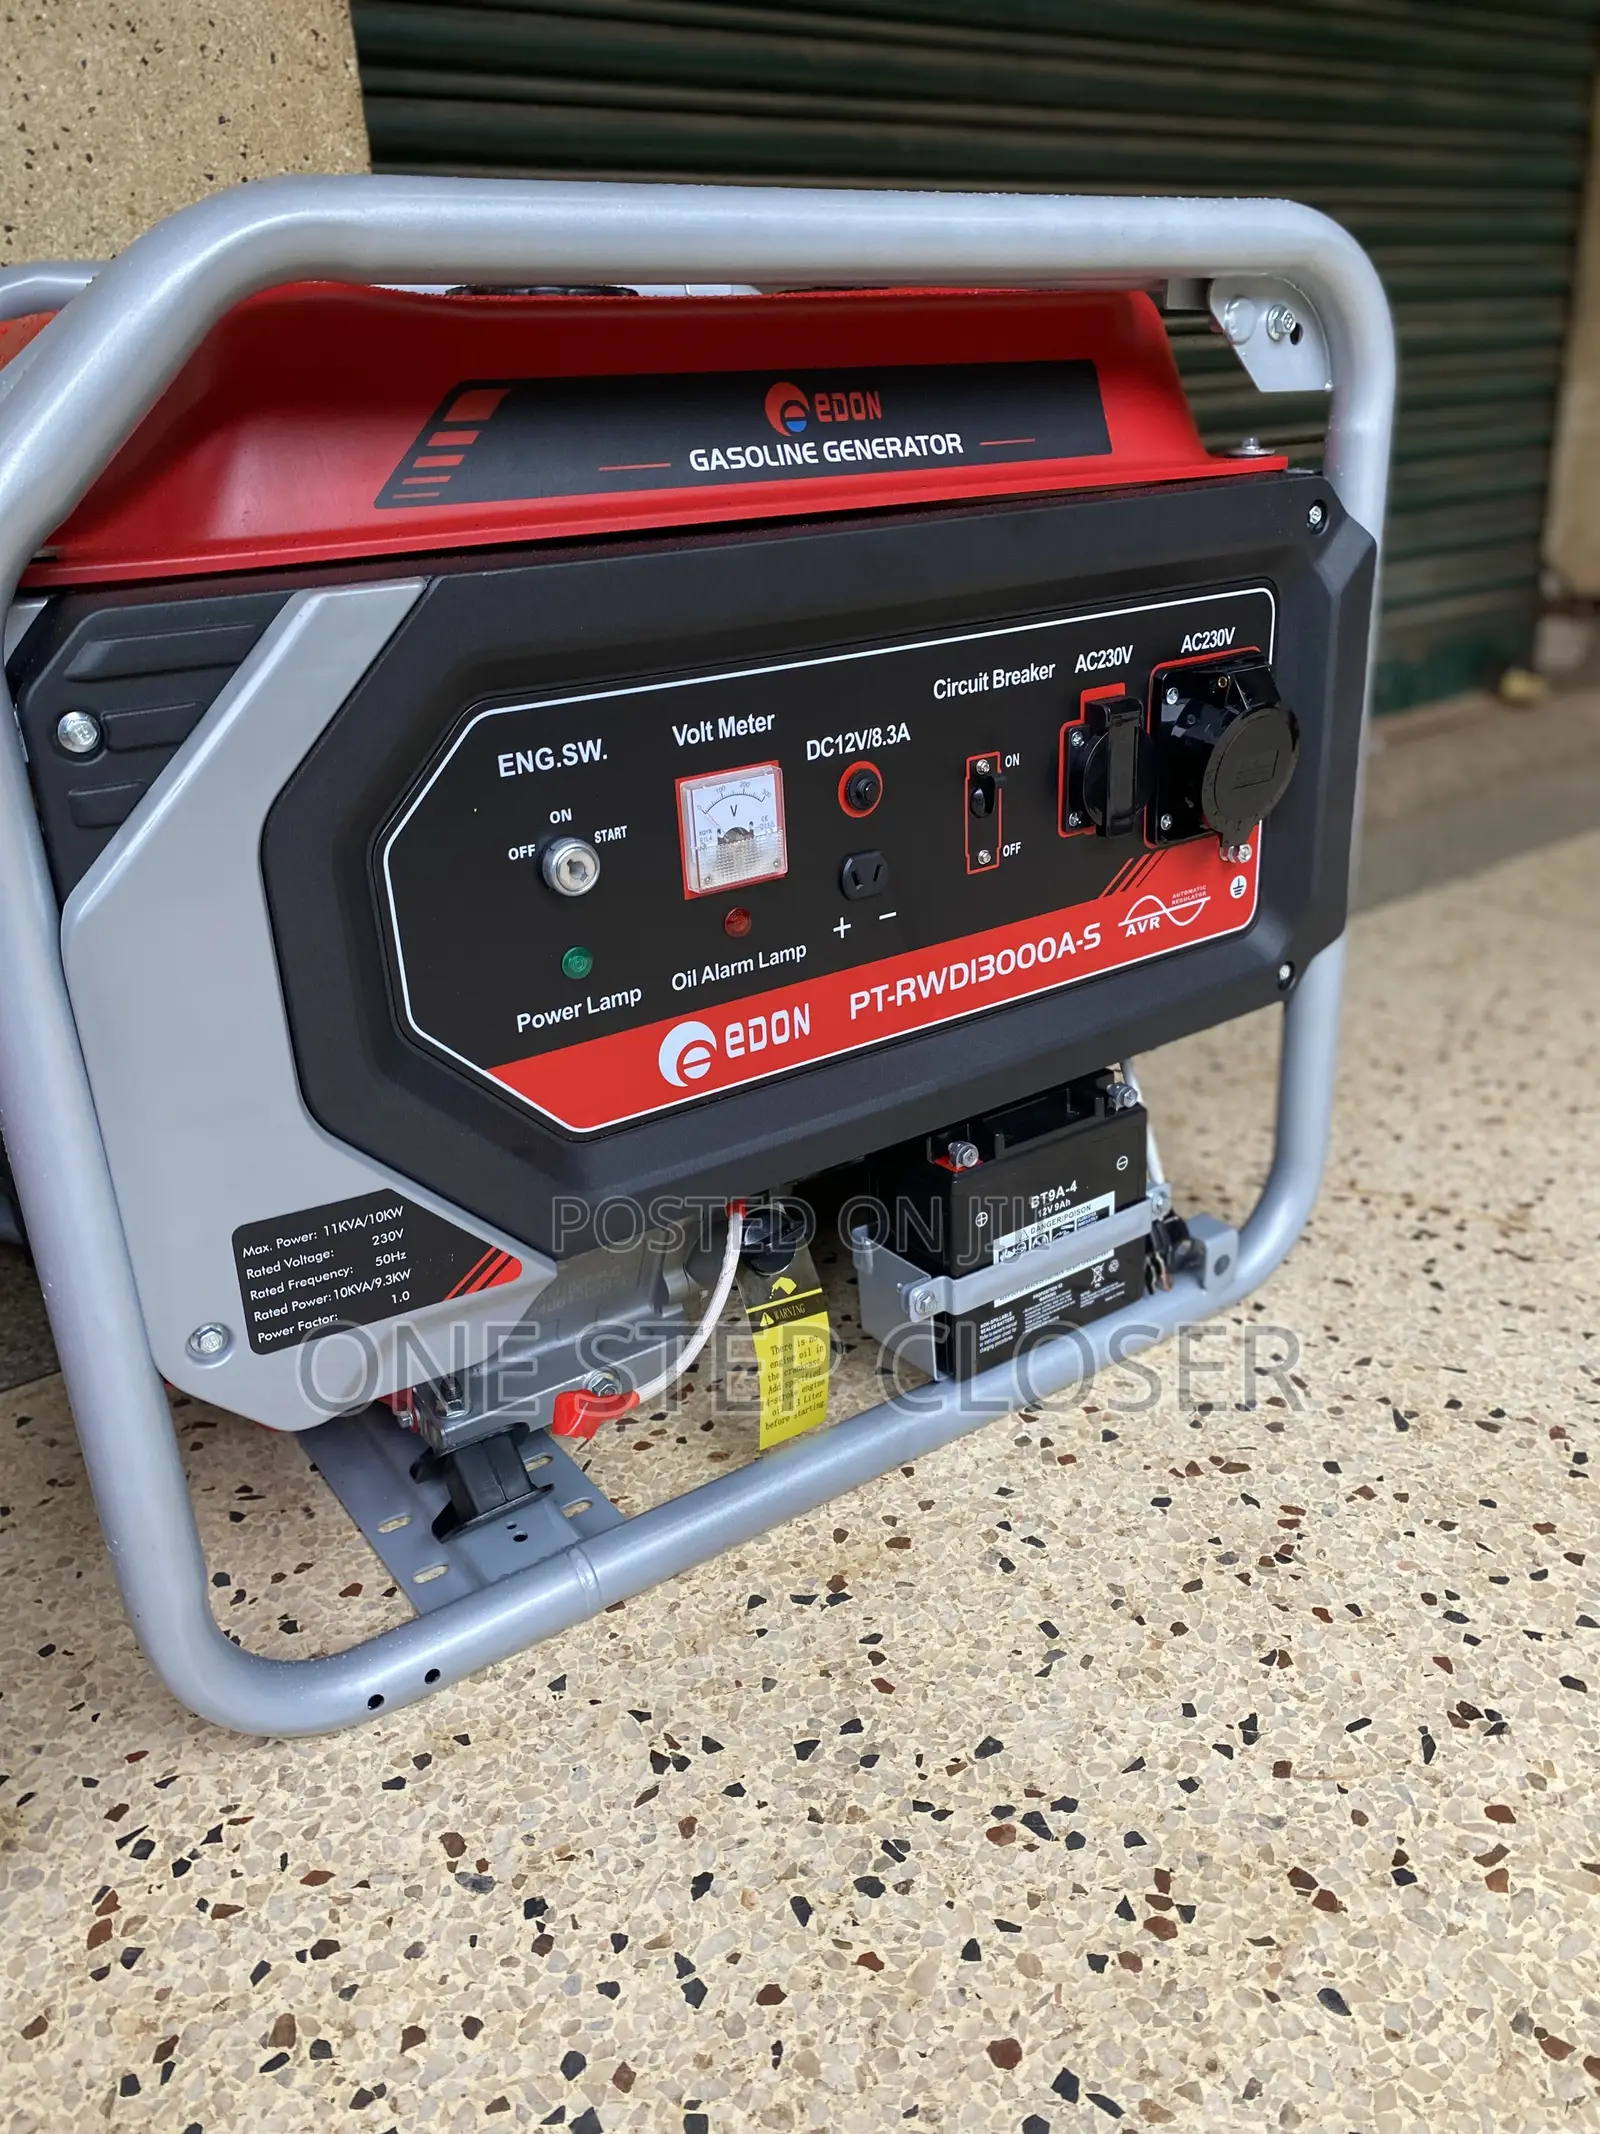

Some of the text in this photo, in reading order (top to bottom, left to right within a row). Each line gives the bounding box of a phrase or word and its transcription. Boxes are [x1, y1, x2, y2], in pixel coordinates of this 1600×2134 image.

[689, 433, 963, 473] GASOLINE GENERATOR
[1181, 626, 1236, 653] AC230V
[1075, 645, 1133, 673] AC230V
[933, 662, 1056, 700] Circuit Breaker
[671, 712, 775, 747] Volt Meter
[806, 722, 911, 760] DC12V/8.3A
[497, 738, 608, 778] ENG.SW.
[1004, 752, 1020, 768] ON
[549, 808, 573, 824] ON
[730, 804, 738, 817] V
[594, 825, 628, 844] START
[508, 844, 536, 861] OFF
[1002, 841, 1022, 858] OFF
[1172, 884, 1207, 899] AUTOMATIC
[1125, 916, 1161, 938] AVR
[671, 943, 807, 991] Oil Alarm Lamp
[517, 987, 642, 1032] Power Lamp
[1030, 1180, 1078, 1209] BT9A-4
[1037, 1199, 1071, 1218] 12V 9Ah
[242, 1205, 404, 1258] Max. Power: 11KVA/10KW
[246, 1228, 405, 1280] Rated Voltage: 230V
[250, 1251, 407, 1301] Rated Frequency: 50Hz
[254, 1268, 412, 1322] Rated Power: 10KVA/9.3KW
[257, 1290, 410, 1344] Power Factor: 1.0
[773, 1303, 806, 1320] WARNING
[770, 1342, 793, 1356] There
[797, 1338, 805, 1347] is
[799, 1348, 811, 1359] oil
[804, 1390, 824, 1404] Liter
[765, 1415, 791, 1431] before
